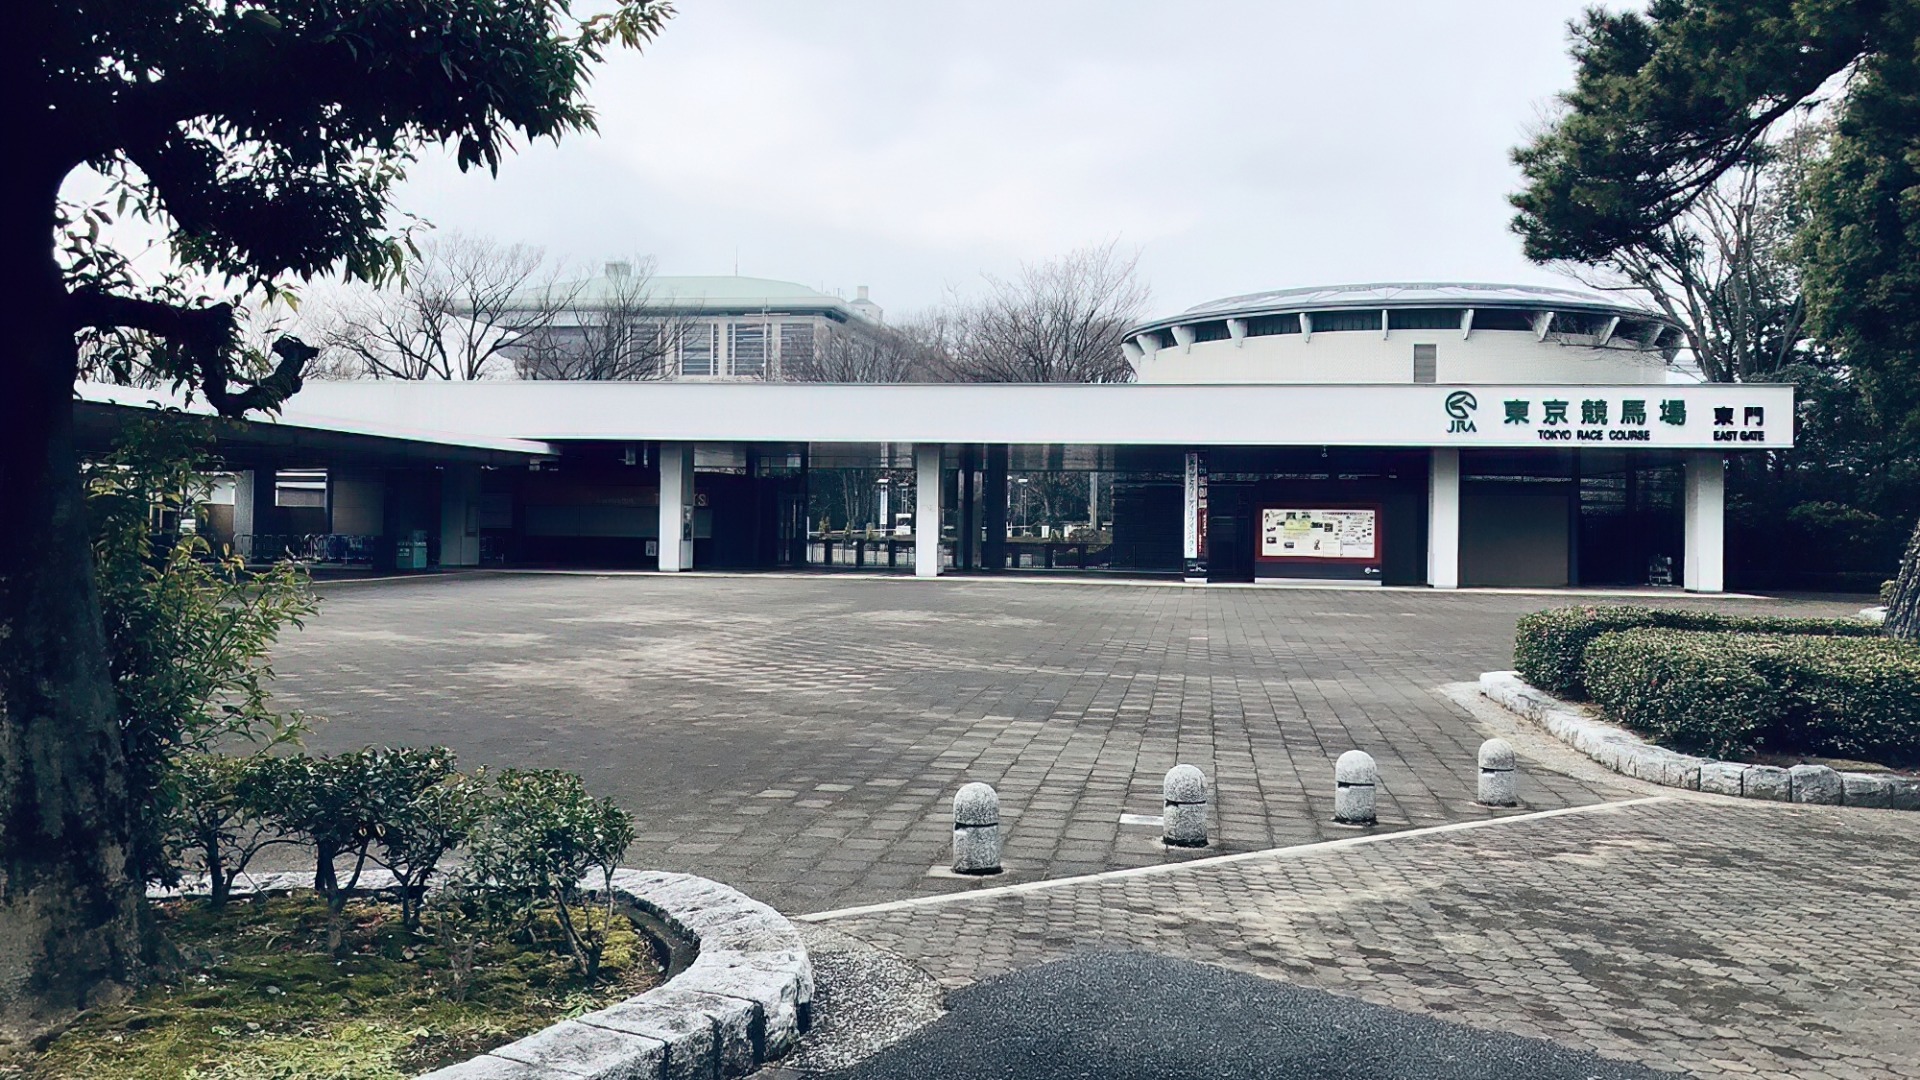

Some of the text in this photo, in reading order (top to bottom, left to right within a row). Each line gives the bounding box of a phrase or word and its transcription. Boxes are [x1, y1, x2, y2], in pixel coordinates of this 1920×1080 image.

[1504, 399, 1686, 425] 東京競馬場
[1713, 406, 1764, 426] 東門
[1446, 420, 1477, 433] JRA
[1538, 430, 1650, 440] TOKYO RACE COURSE
[1713, 431, 1764, 441] EAST GATE
